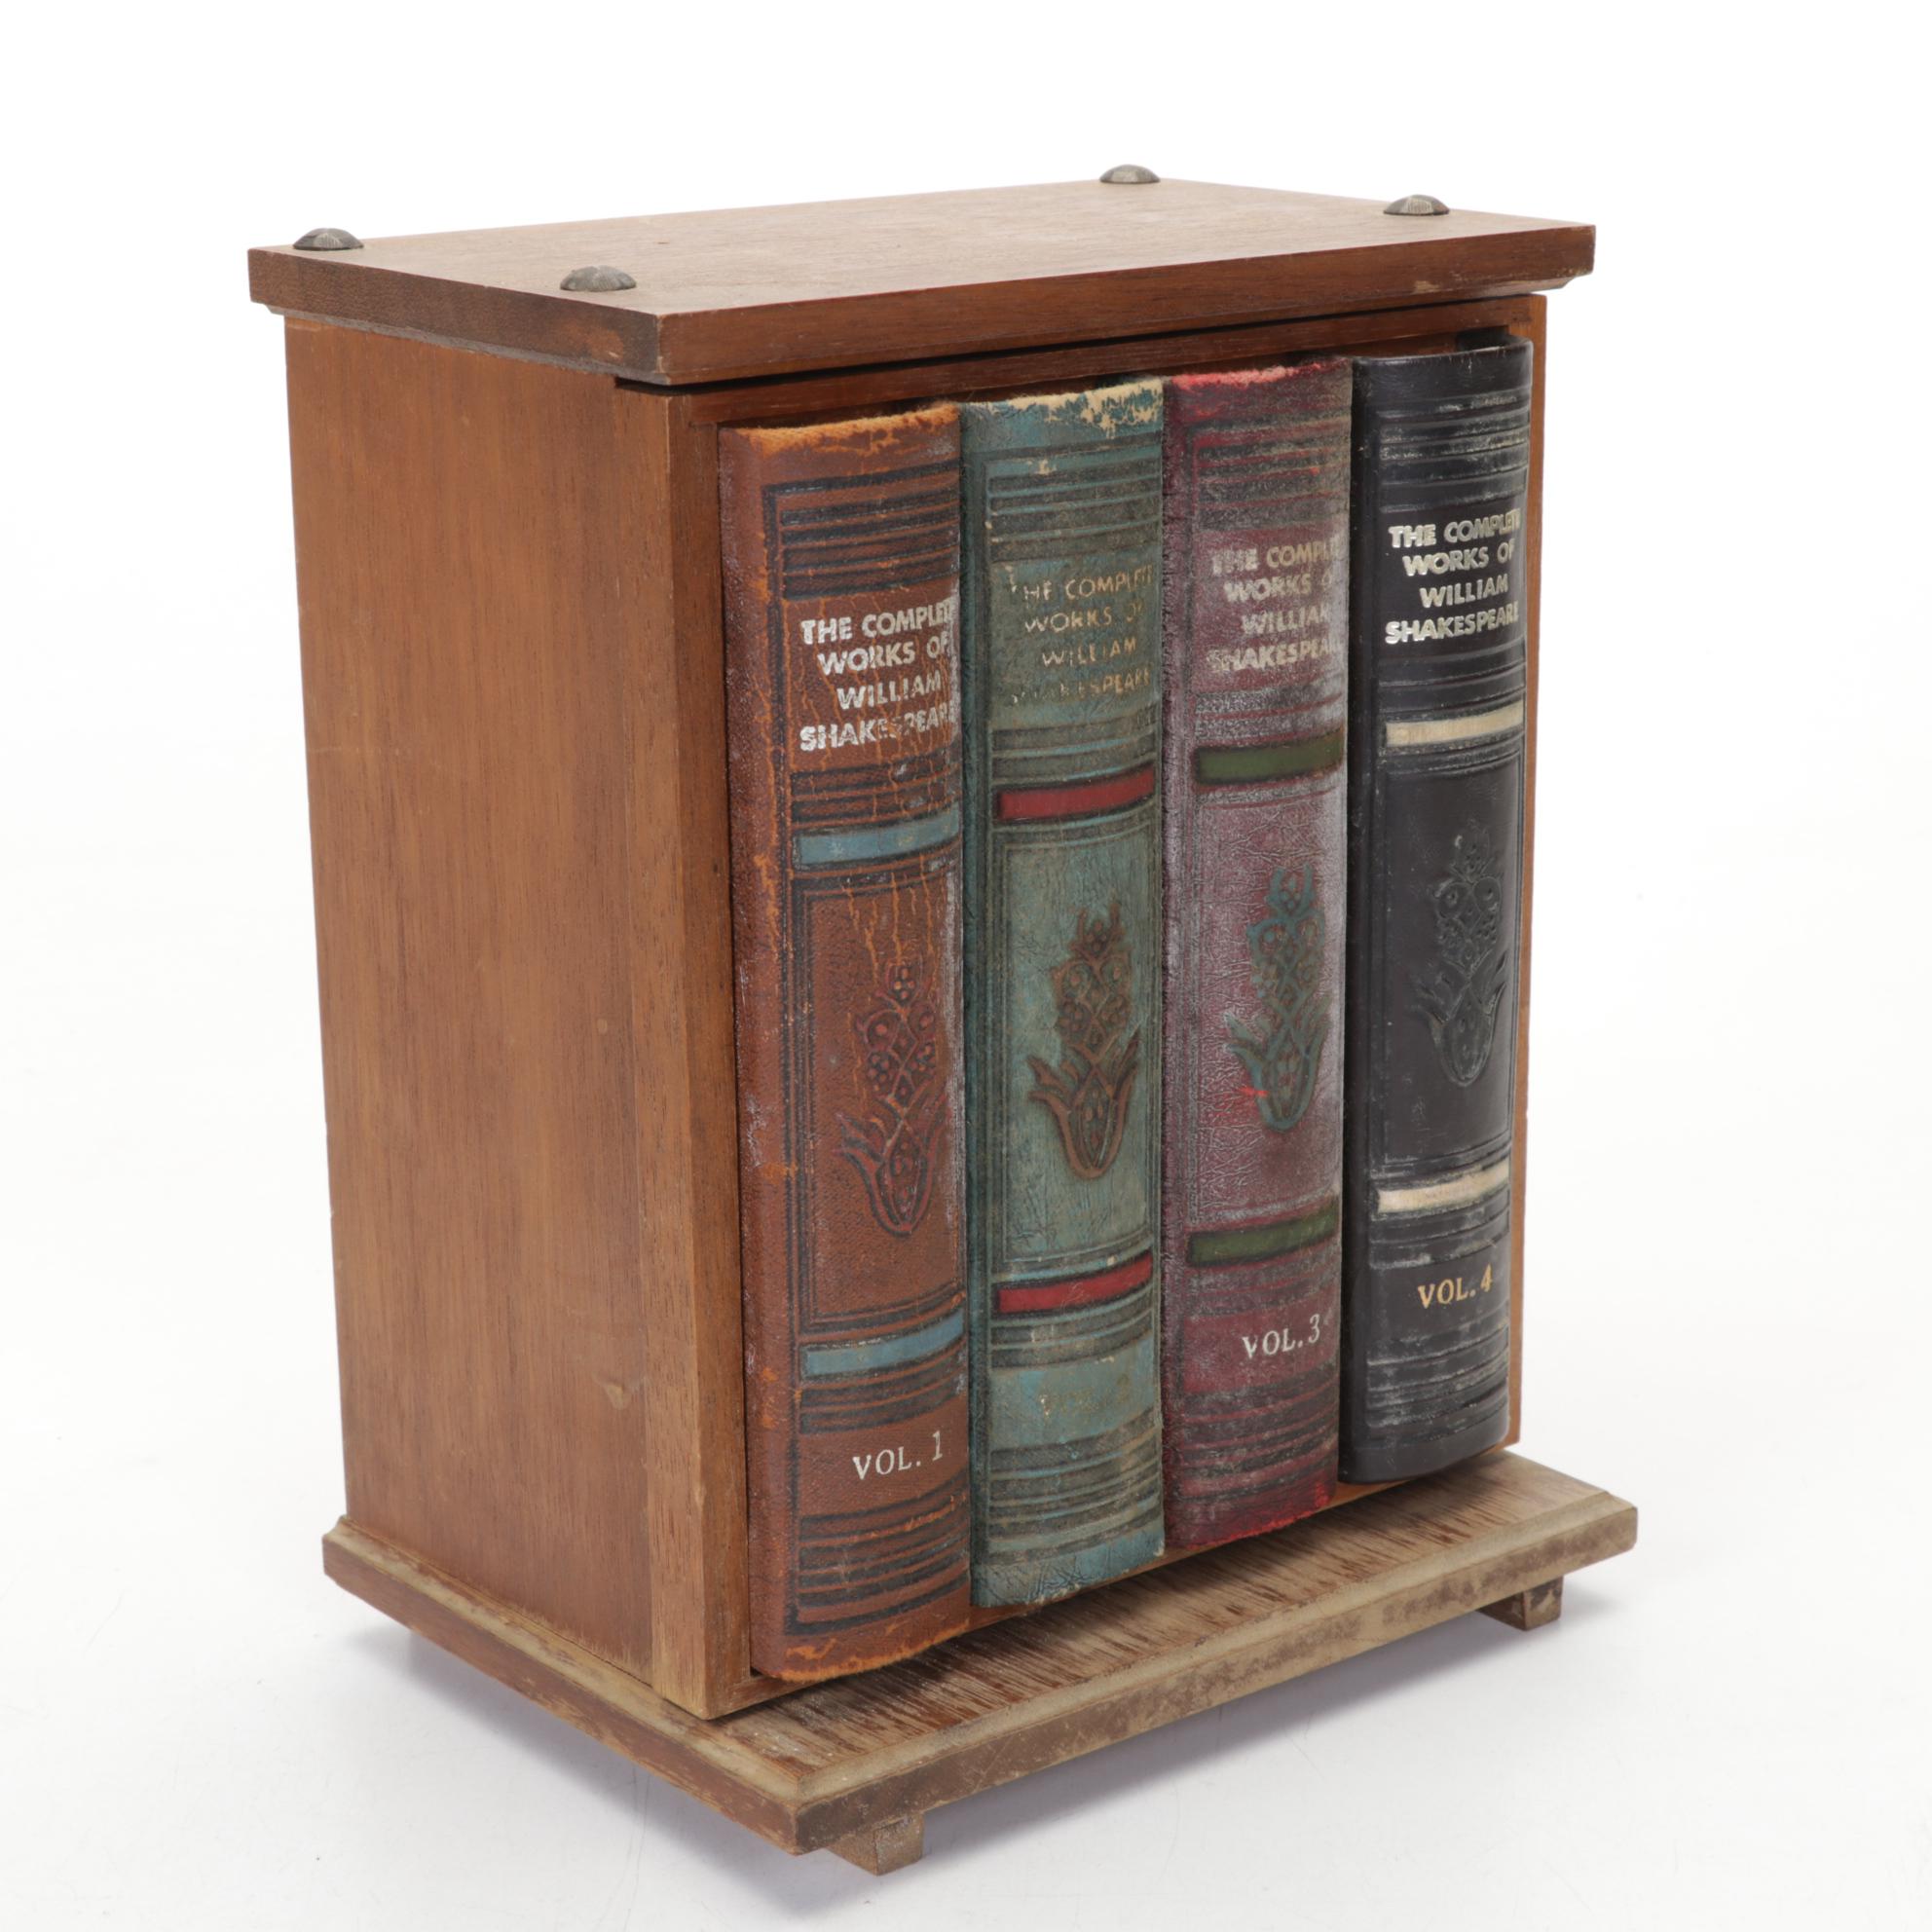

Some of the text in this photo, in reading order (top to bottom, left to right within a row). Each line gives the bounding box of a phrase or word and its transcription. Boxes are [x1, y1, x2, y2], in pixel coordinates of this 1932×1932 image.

[1388, 524, 1436, 548] THE
[1211, 548, 1258, 576] THE
[1402, 538, 1515, 576] WORKS OF
[1223, 573, 1311, 603] WORKS
[1419, 574, 1508, 609] WILLIAM
[800, 616, 853, 645] THE
[1385, 601, 1519, 644] SHAKESPEARE
[817, 641, 916, 676] WORKS
[1042, 636, 1136, 667] WILLIAM
[836, 669, 942, 710] WILLIAM
